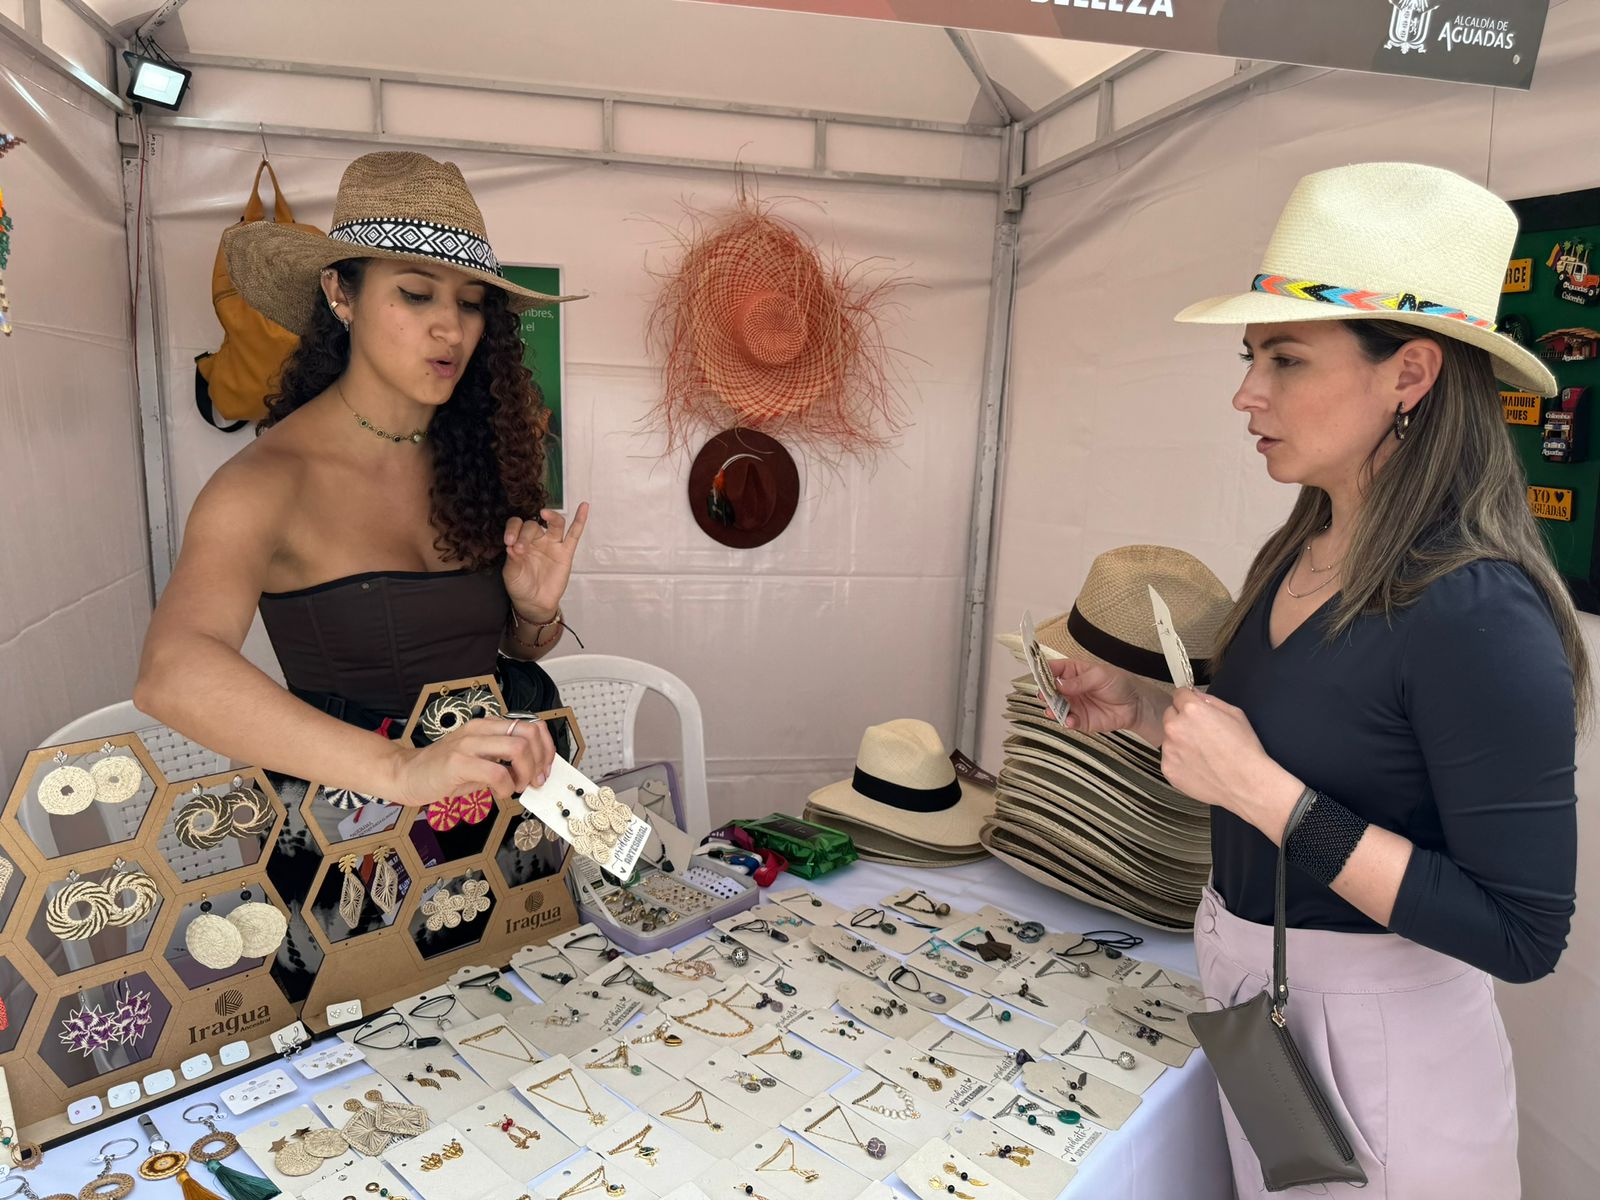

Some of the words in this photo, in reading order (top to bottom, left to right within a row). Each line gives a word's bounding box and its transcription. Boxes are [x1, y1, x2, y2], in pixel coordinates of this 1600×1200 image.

[1454, 15, 1495, 30] ALCALDÍA
[1497, 20, 1509, 32] DE
[1438, 21, 1514, 52] AGUADAS
[1562, 291, 1585, 305] Colombia
[519, 307, 554, 319] mbres,
[526, 321, 535, 332] el
[1506, 409, 1528, 421] PUES
[1533, 488, 1551, 504] YO
[1532, 502, 1568, 518] GUADAS
[624, 825, 648, 865] ARTESANAL
[505, 906, 562, 935] Iragua
[188, 1005, 271, 1045] Iragua
[240, 1016, 271, 1033] Ancestral
